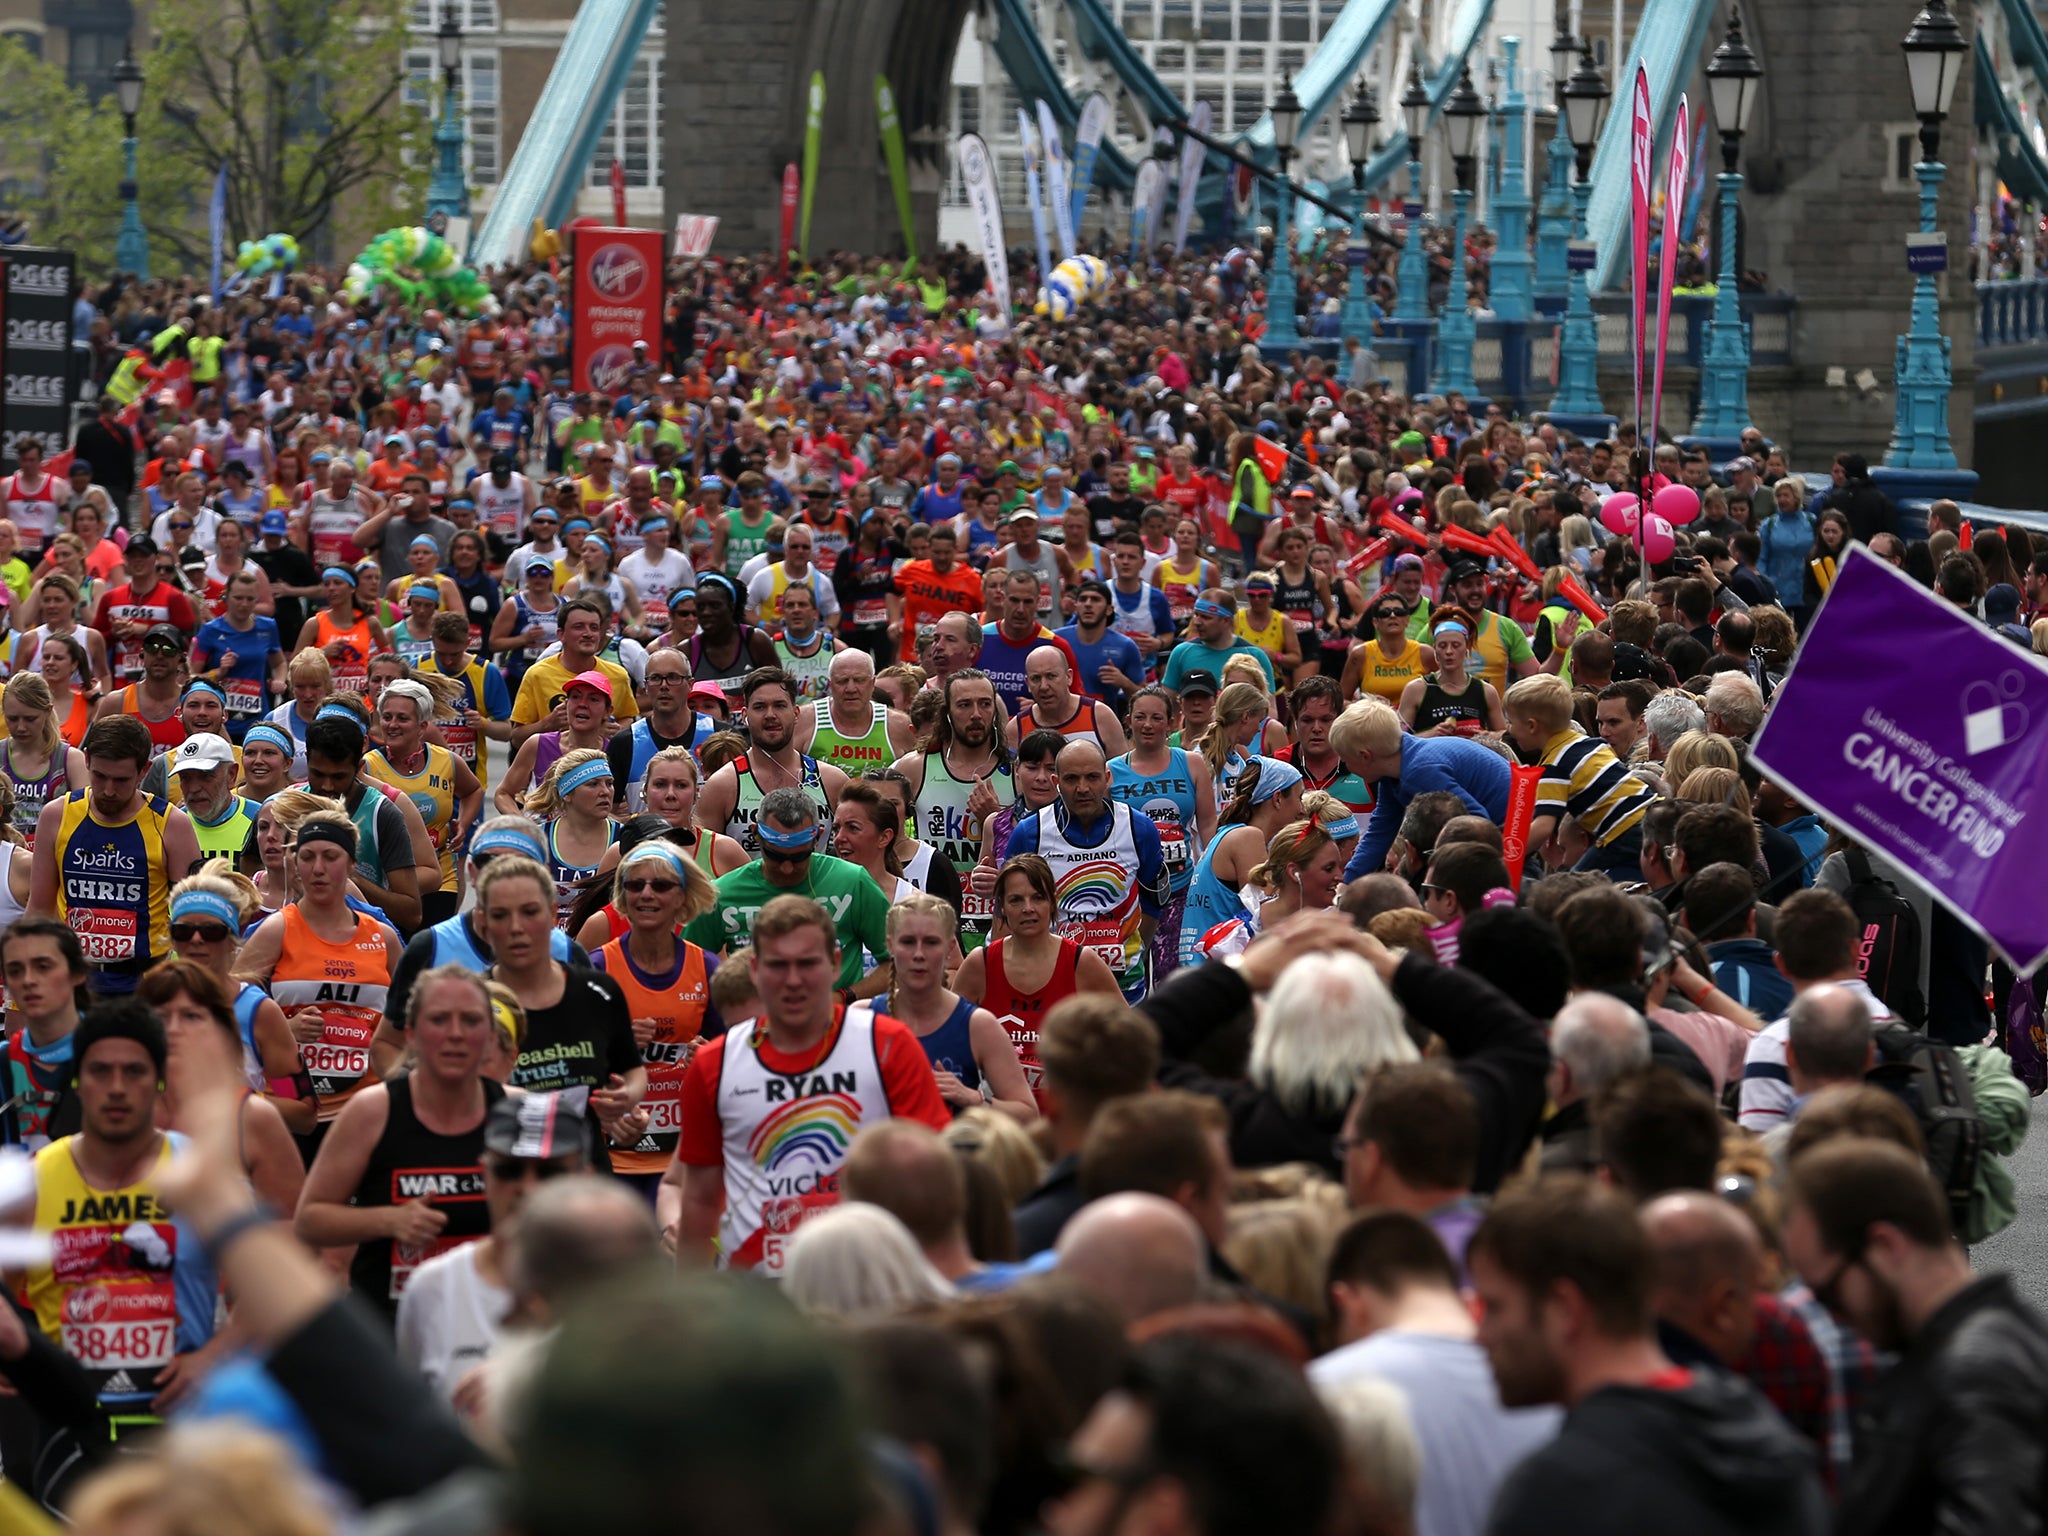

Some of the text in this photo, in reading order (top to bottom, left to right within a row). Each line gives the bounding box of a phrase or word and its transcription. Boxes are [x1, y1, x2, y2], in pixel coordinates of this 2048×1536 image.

[593, 251, 642, 293] Virgin
[588, 306, 645, 318] money
[592, 321, 642, 338] giving
[912, 582, 967, 605] SHANE
[122, 608, 154, 618] ROSS
[1374, 664, 1412, 678] Rachel
[228, 697, 260, 710] 1464
[831, 745, 882, 760] JOHN
[1861, 706, 1940, 770] University
[1935, 756, 1986, 801] College
[1124, 779, 1188, 799] KATE
[1843, 732, 2006, 859] CANCER FUND
[1511, 778, 1530, 837] moneygiving
[72, 847, 135, 870] Sparks
[1067, 851, 1117, 862] ADRIANO
[67, 878, 141, 901] CHRIS
[69, 909, 134, 931] Virgin money
[1087, 928, 1120, 938] money
[355, 942, 386, 951] sense
[323, 959, 355, 968] sense
[325, 967, 356, 977] says
[315, 983, 360, 1003] ALI
[679, 992, 706, 1001] sense
[325, 1024, 368, 1040] money
[643, 1044, 680, 1063] UE
[647, 1080, 684, 1092] money
[766, 1071, 857, 1102] RYAN
[400, 1175, 458, 1195] WAR
[112, 1293, 170, 1309] money
[66, 1325, 170, 1360] 38487
